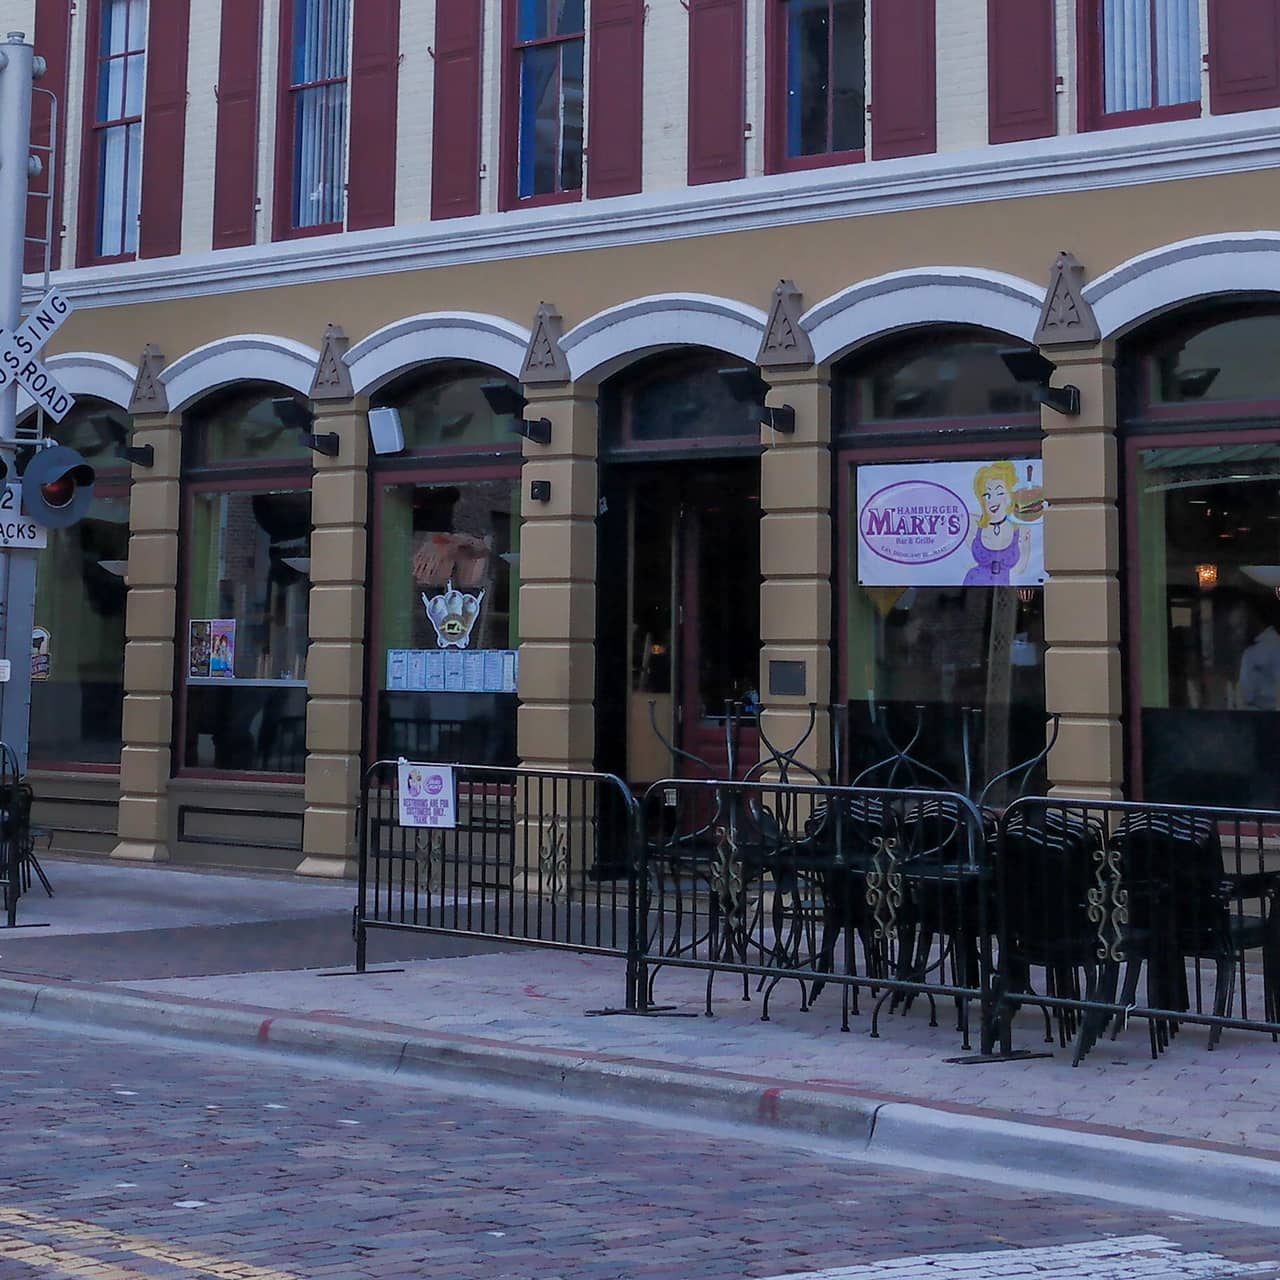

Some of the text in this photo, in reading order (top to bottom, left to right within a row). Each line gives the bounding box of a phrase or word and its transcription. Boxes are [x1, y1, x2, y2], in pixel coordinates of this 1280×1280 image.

[20, 360, 68, 414] ROAD
[1, 488, 14, 510] 2
[897, 505, 959, 515] HAMBURGER
[866, 507, 961, 536] MARY'S
